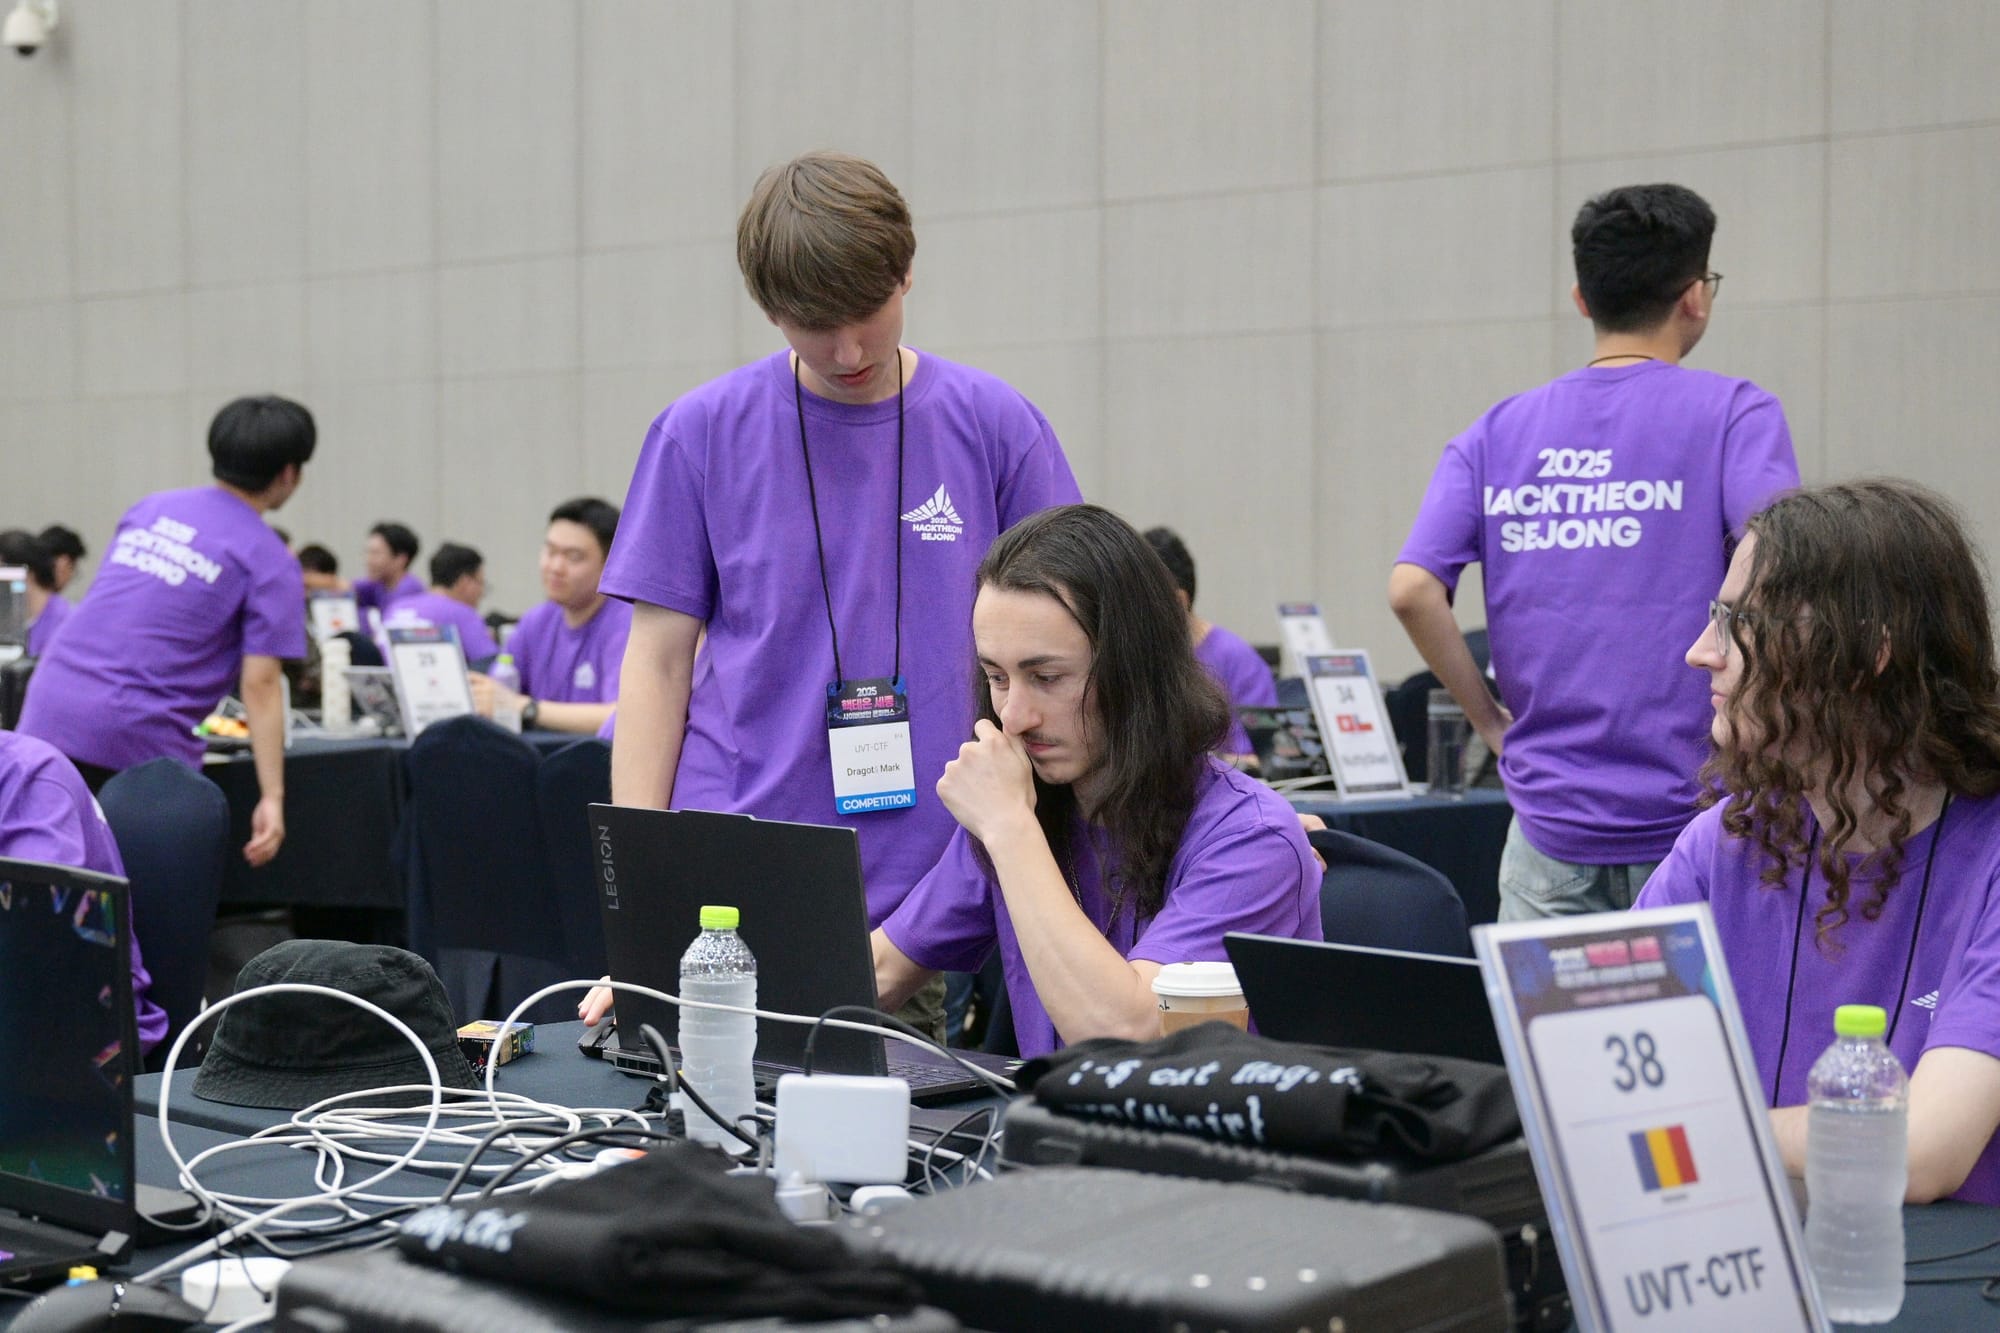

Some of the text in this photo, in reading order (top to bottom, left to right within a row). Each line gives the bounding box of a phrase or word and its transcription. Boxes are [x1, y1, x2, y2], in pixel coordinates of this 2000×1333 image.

[1536, 447, 1613, 479] 2025
[912, 523, 963, 534] HACKTHEON
[921, 532, 956, 542] SEJONG
[1500, 516, 1642, 553] SEJONG
[856, 686, 878, 697] 2025
[854, 741, 889, 753] UVT-CTF
[880, 763, 901, 773] Mark
[842, 793, 911, 811] COMPETITION
[598, 825, 620, 910] LEGION
[1605, 1031, 1666, 1093] 38
[1624, 1247, 1766, 1318] UVT-CTF
